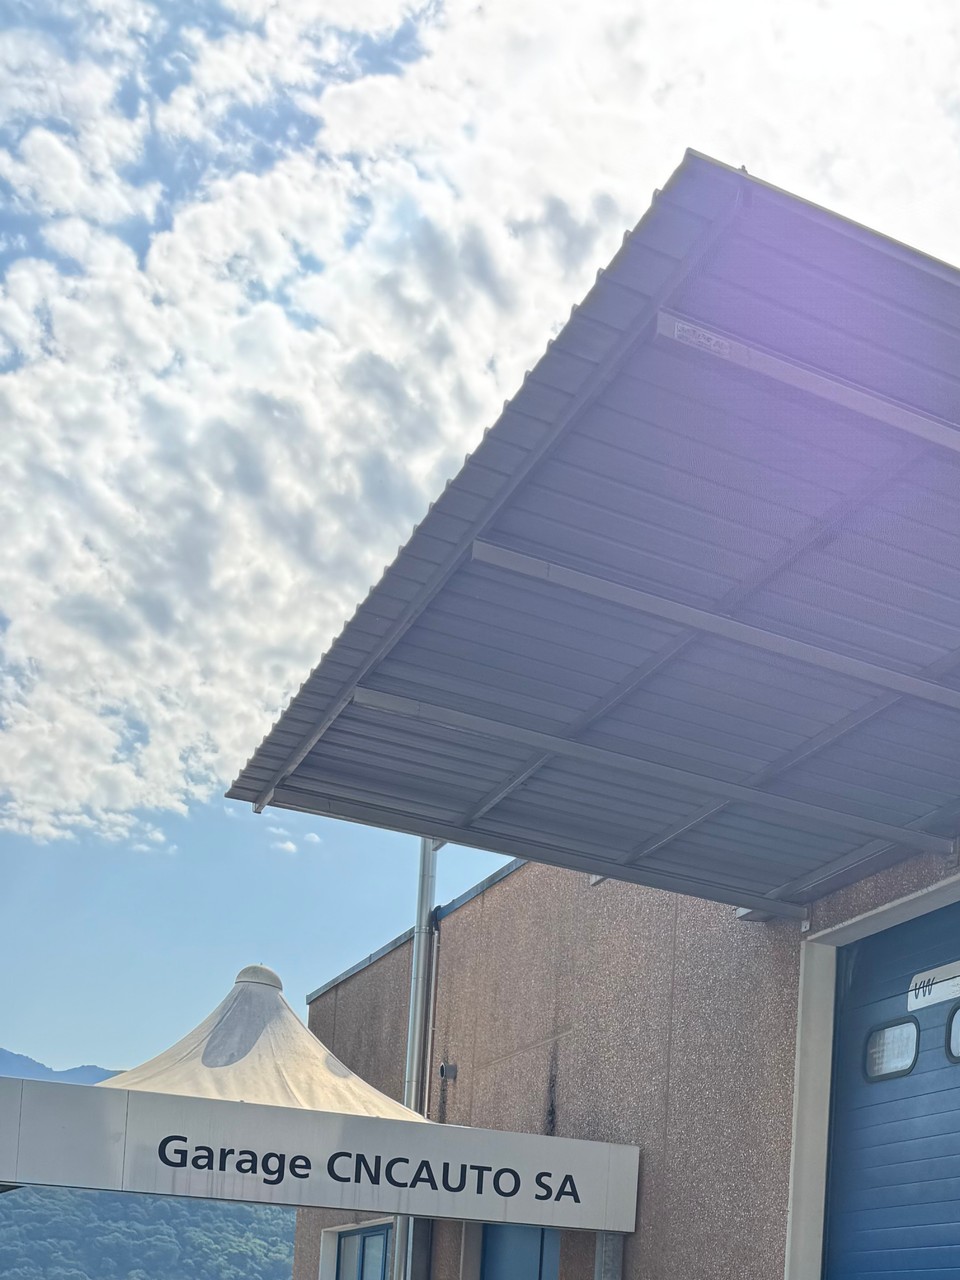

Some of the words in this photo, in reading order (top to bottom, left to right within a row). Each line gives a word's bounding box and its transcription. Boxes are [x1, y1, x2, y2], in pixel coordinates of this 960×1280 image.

[914, 976, 936, 999] VW
[157, 1134, 312, 1186] Garage
[326, 1150, 521, 1199] CNCAUTO
[533, 1171, 582, 1204] SA
